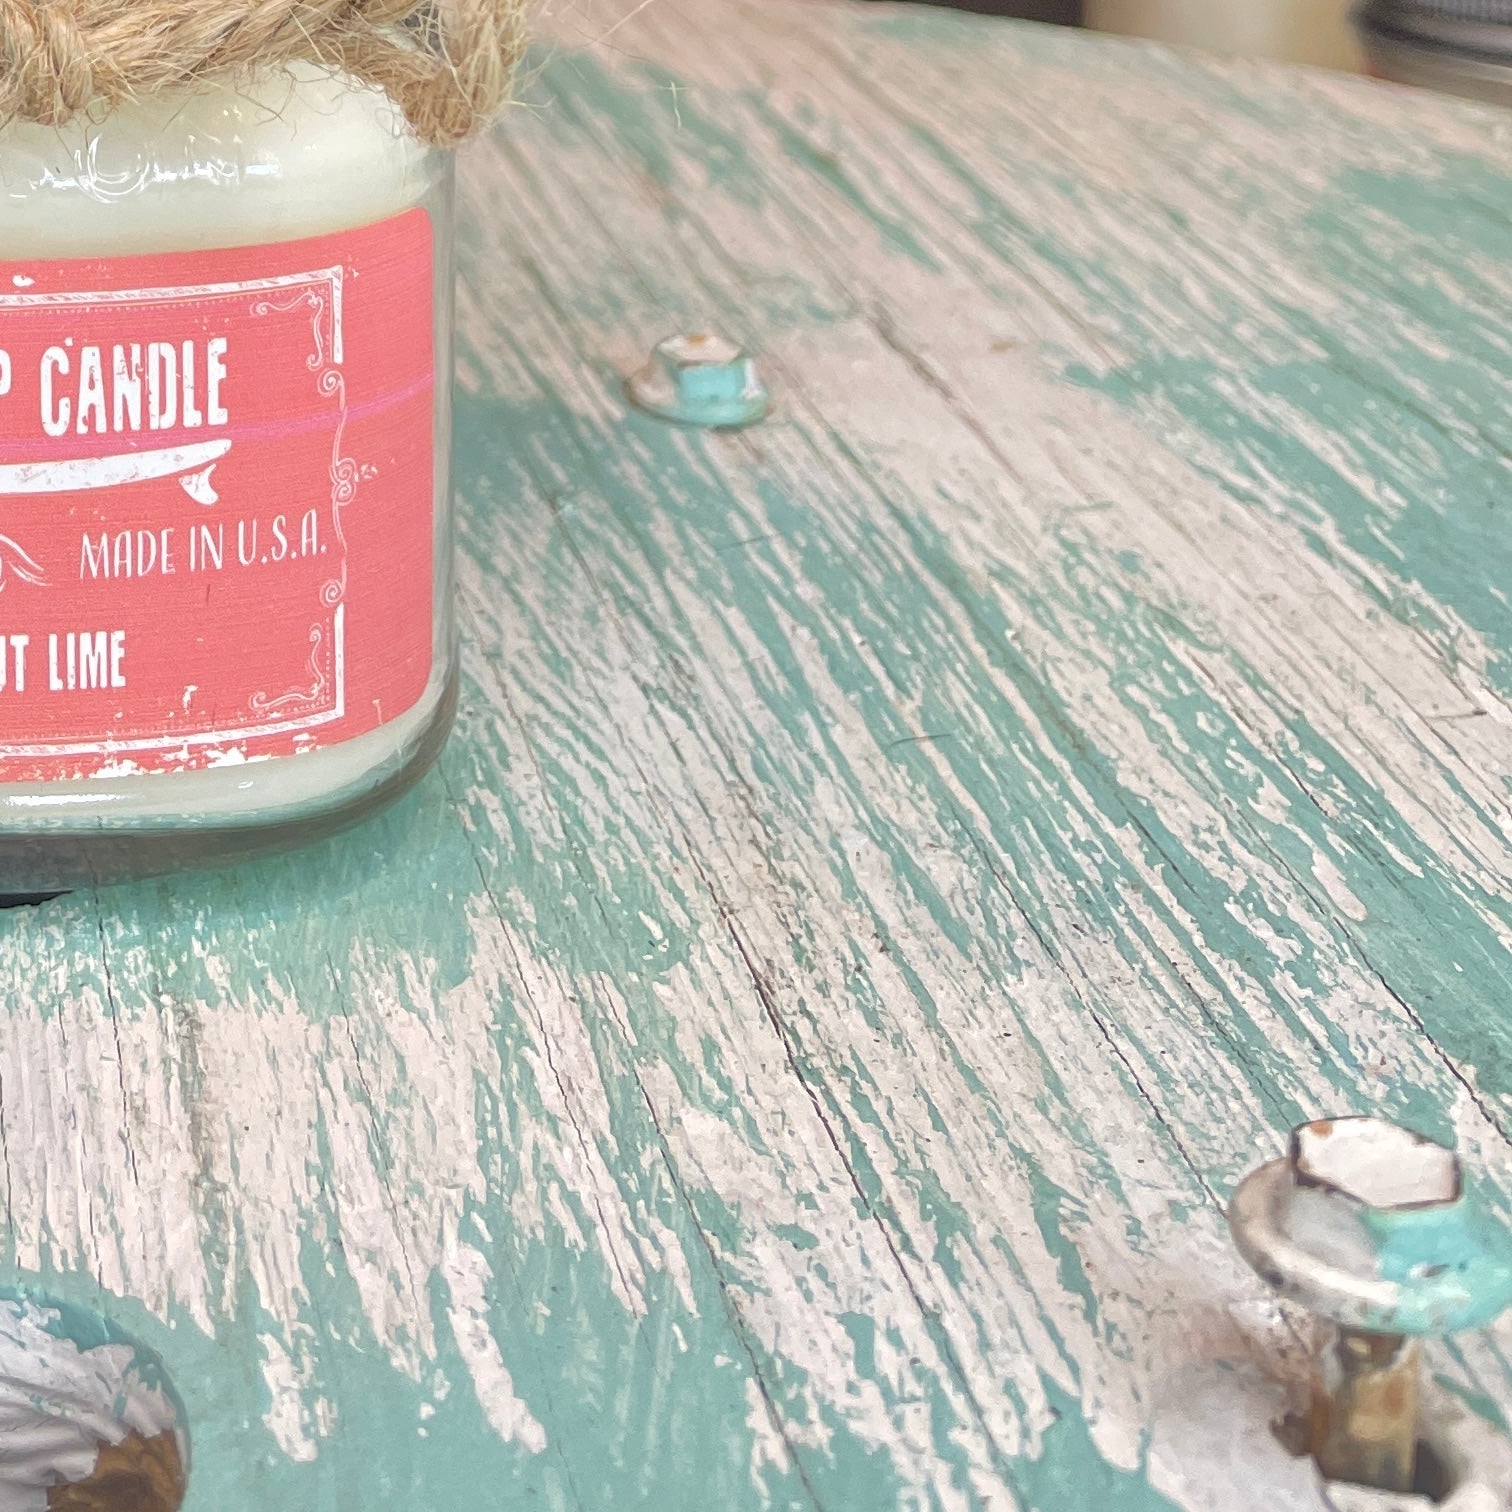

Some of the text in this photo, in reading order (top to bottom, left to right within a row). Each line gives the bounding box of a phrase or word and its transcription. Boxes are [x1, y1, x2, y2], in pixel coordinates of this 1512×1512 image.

[39, 337, 229, 437] CANDLE
[79, 508, 327, 579] MADE IN U.S.A.
[48, 629, 127, 691] LIME
